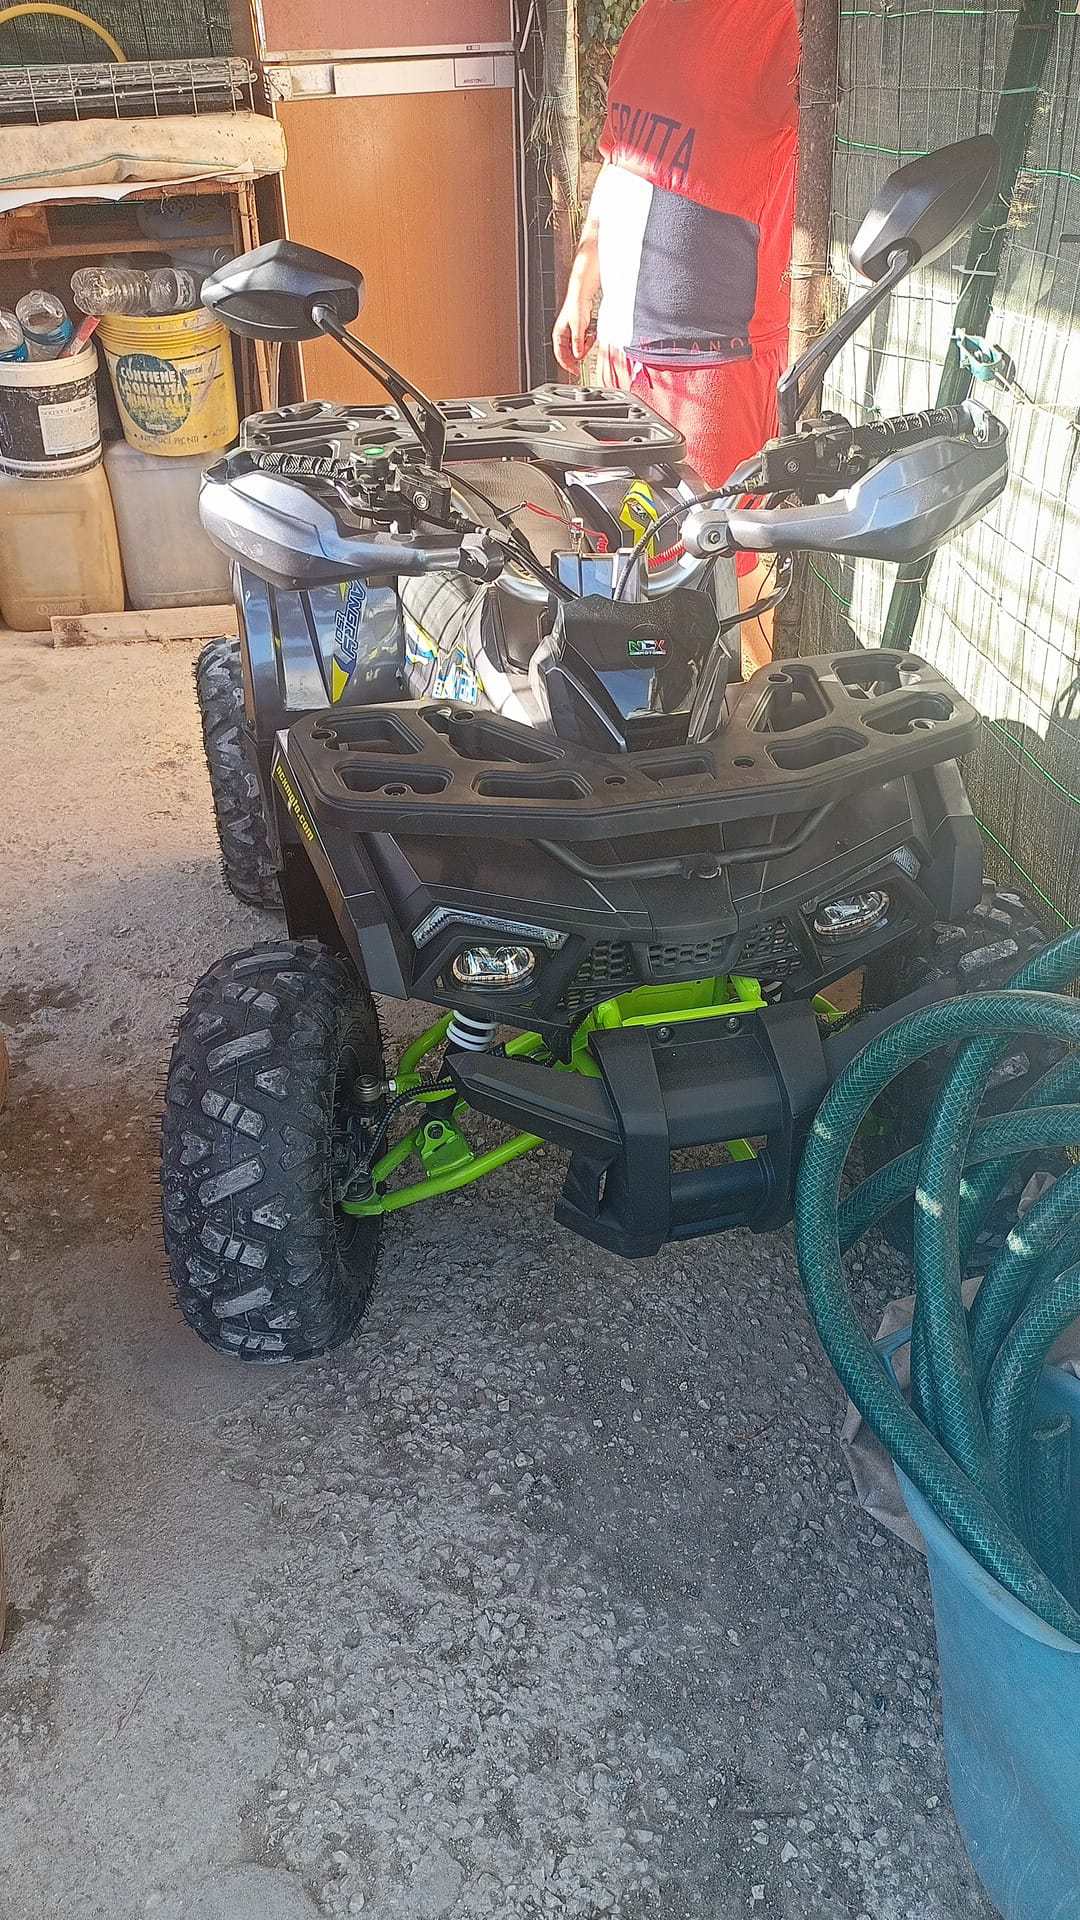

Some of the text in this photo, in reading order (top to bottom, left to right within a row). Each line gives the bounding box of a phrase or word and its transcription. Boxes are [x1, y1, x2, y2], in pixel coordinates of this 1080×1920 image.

[639, 336, 744, 353] MILANO
[120, 366, 177, 383] CONTIENE
[334, 611, 347, 645] 150
[276, 765, 314, 841] ncxmoto.com
